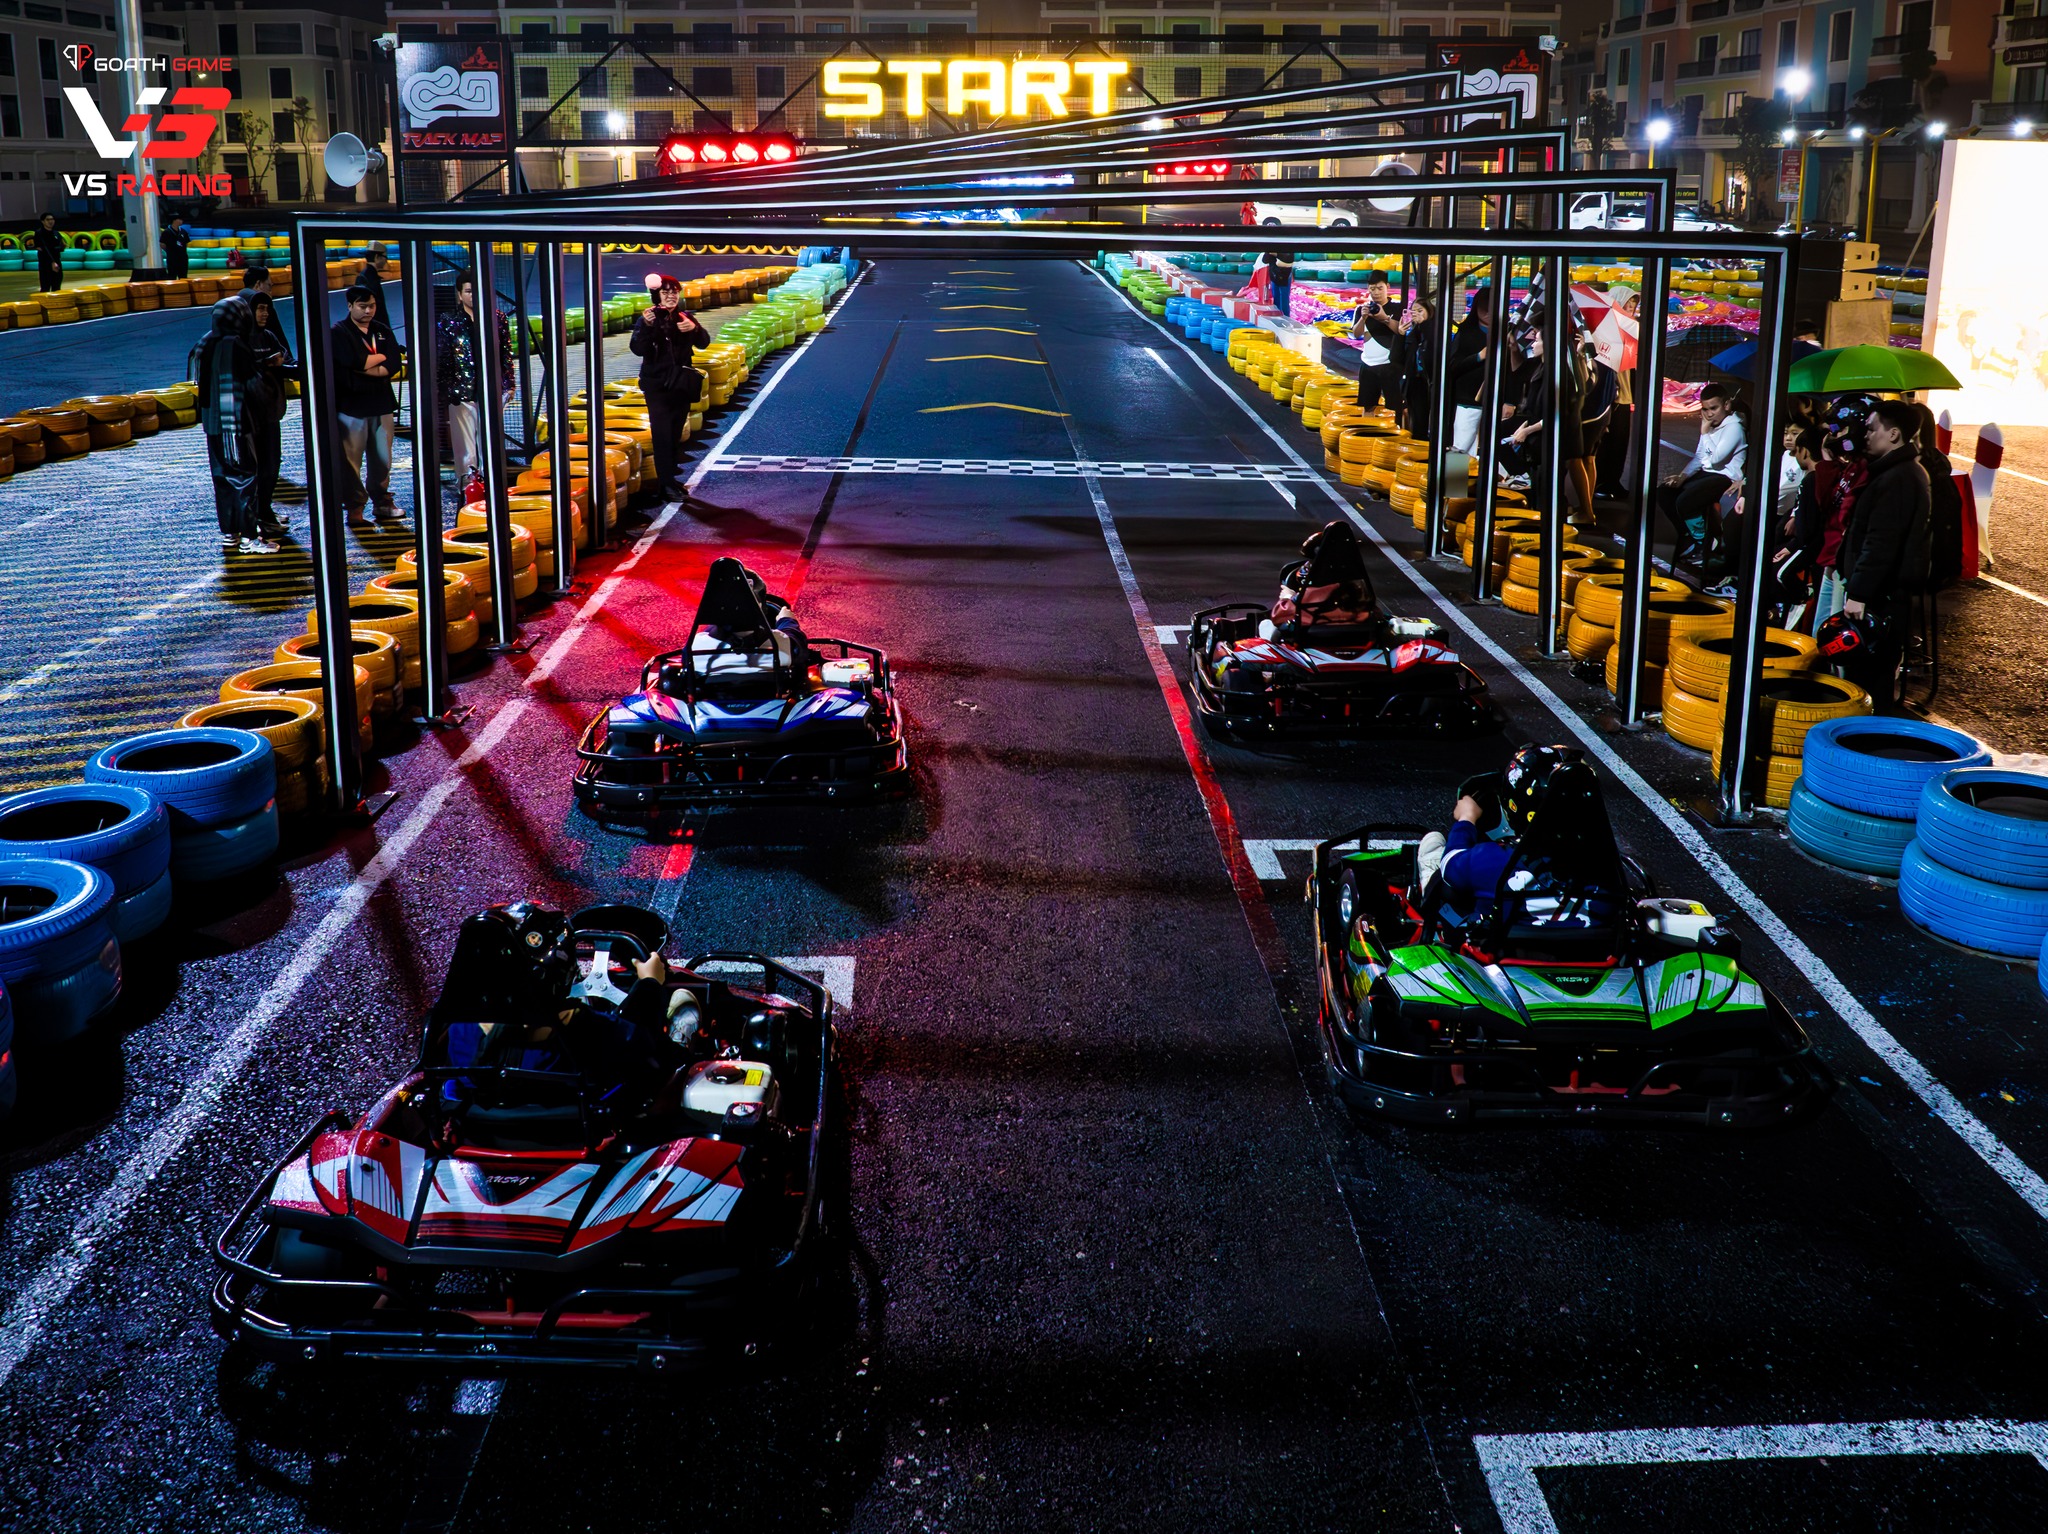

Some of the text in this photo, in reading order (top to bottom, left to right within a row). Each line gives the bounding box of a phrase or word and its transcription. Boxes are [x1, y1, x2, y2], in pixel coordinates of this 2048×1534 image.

[823, 60, 1128, 117] START
[402, 132, 504, 148] TRACK MAP
